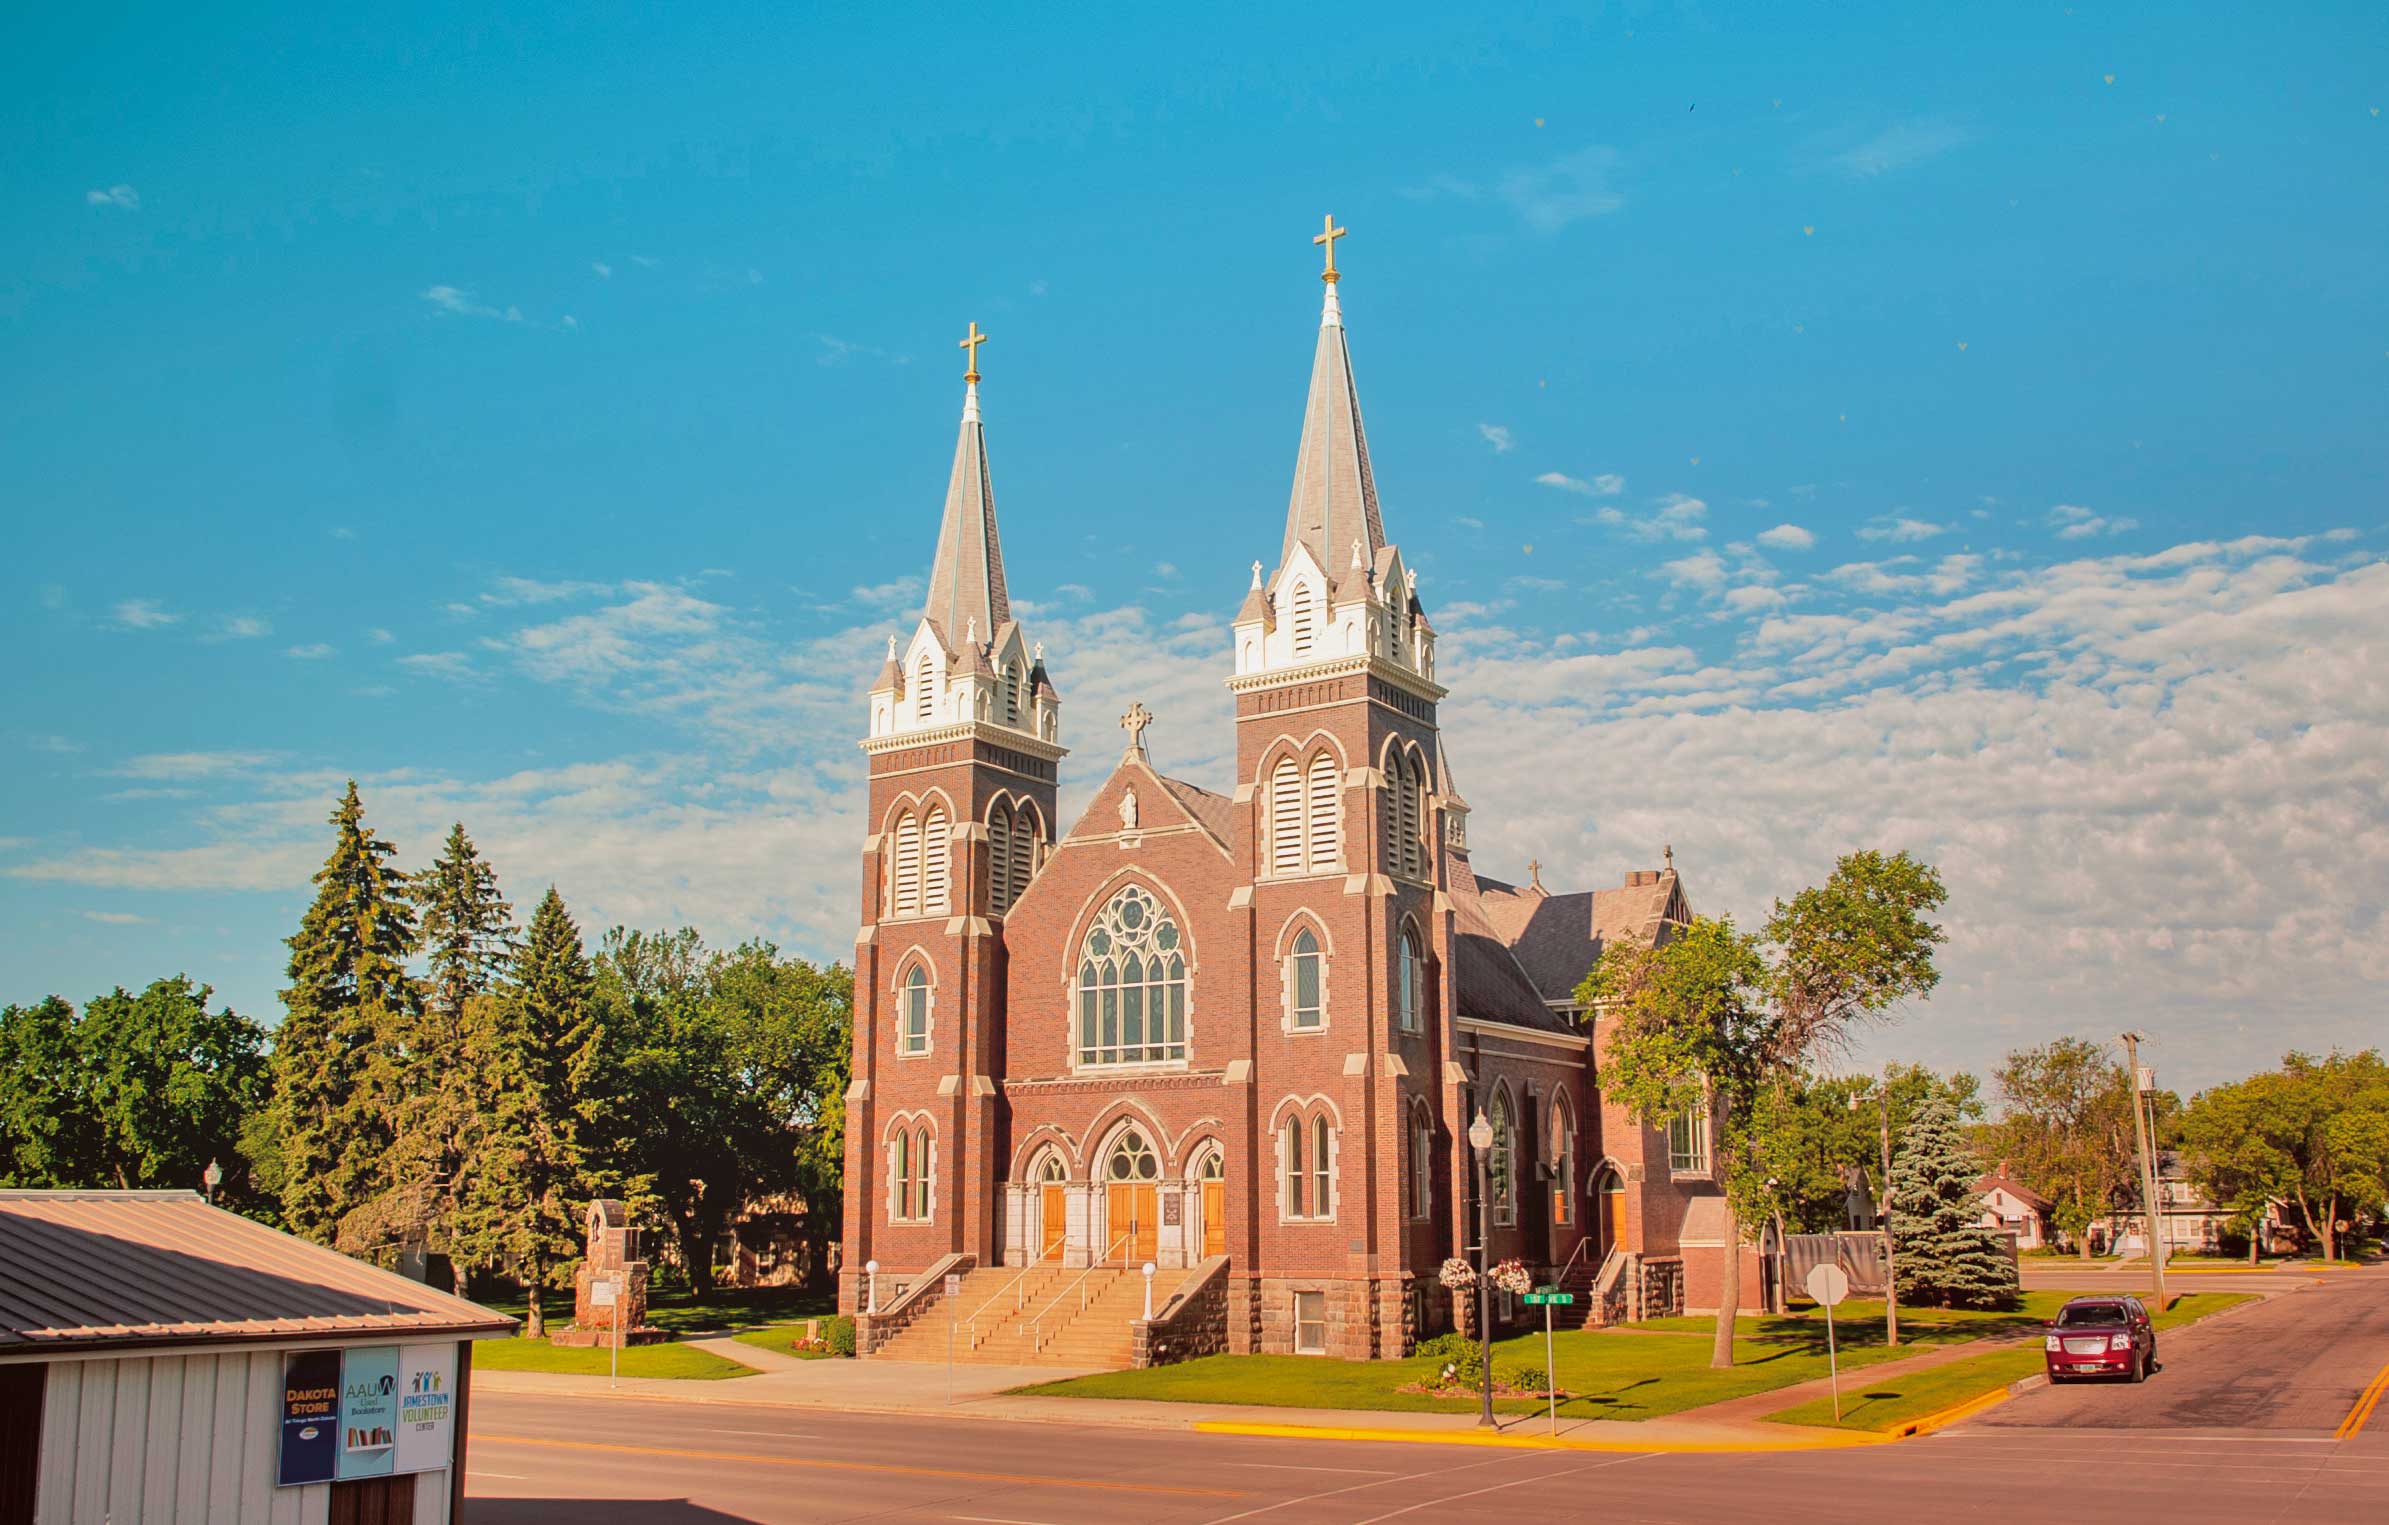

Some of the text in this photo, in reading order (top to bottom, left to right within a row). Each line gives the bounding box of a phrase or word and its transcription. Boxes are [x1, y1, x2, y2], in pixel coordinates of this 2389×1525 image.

[286, 1388, 337, 1402] DAKOTA
[345, 1377, 397, 1398] AAUW
[291, 1402, 330, 1415] STORE
[402, 1392, 449, 1409] JAMESTOWN
[402, 1405, 449, 1423] VOLUNTEER
